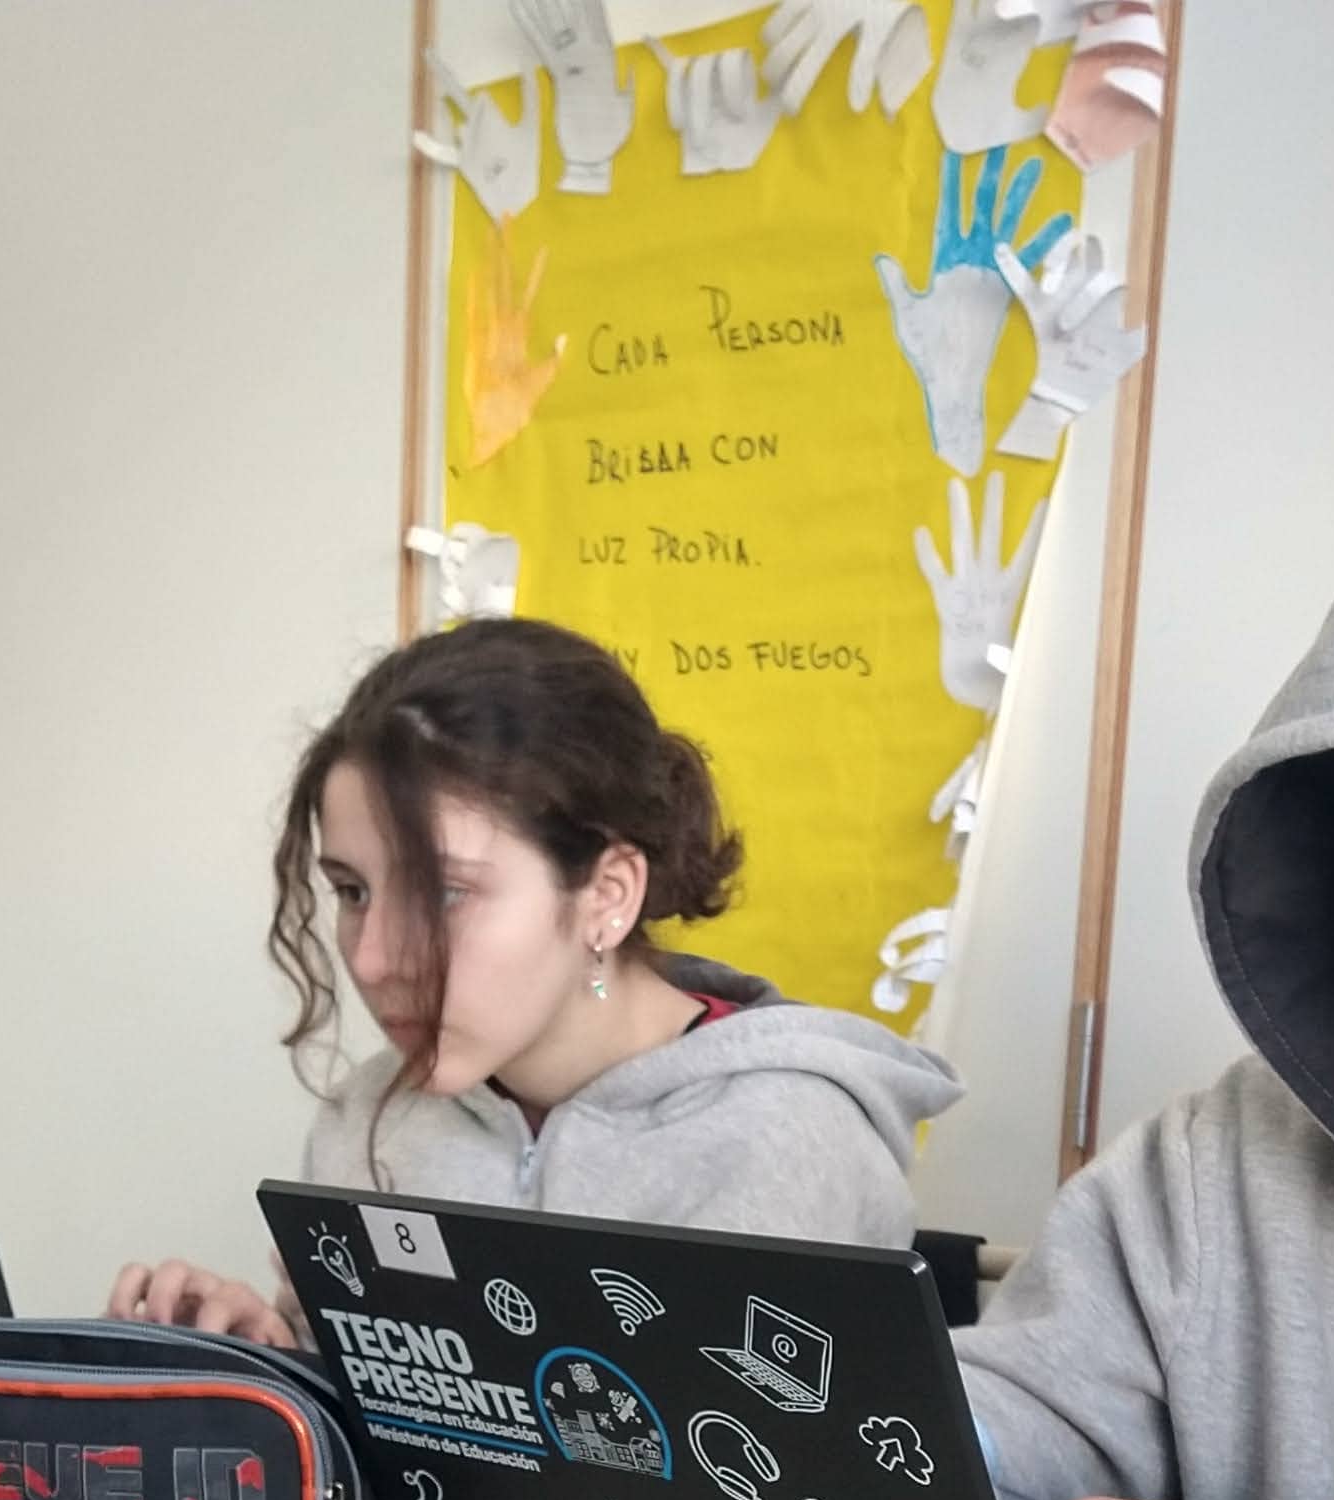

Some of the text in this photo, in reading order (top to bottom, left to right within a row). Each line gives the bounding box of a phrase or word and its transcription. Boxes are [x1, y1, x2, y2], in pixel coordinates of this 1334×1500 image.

[587, 284, 845, 375] CADA PERSONA
[711, 433, 779, 465] CON
[578, 535, 627, 565] LUZ
[670, 639, 732, 676] DOS
[747, 641, 872, 678] FUEGOS
[395, 1222, 416, 1254] 8
[320, 1308, 474, 1375] TECNO
[341, 1354, 537, 1426] PRESENTE
[367, 1422, 541, 1473] Ministerio de Educación
[442, 1412, 463, 1430] en
[464, 1414, 544, 1445] Educación
